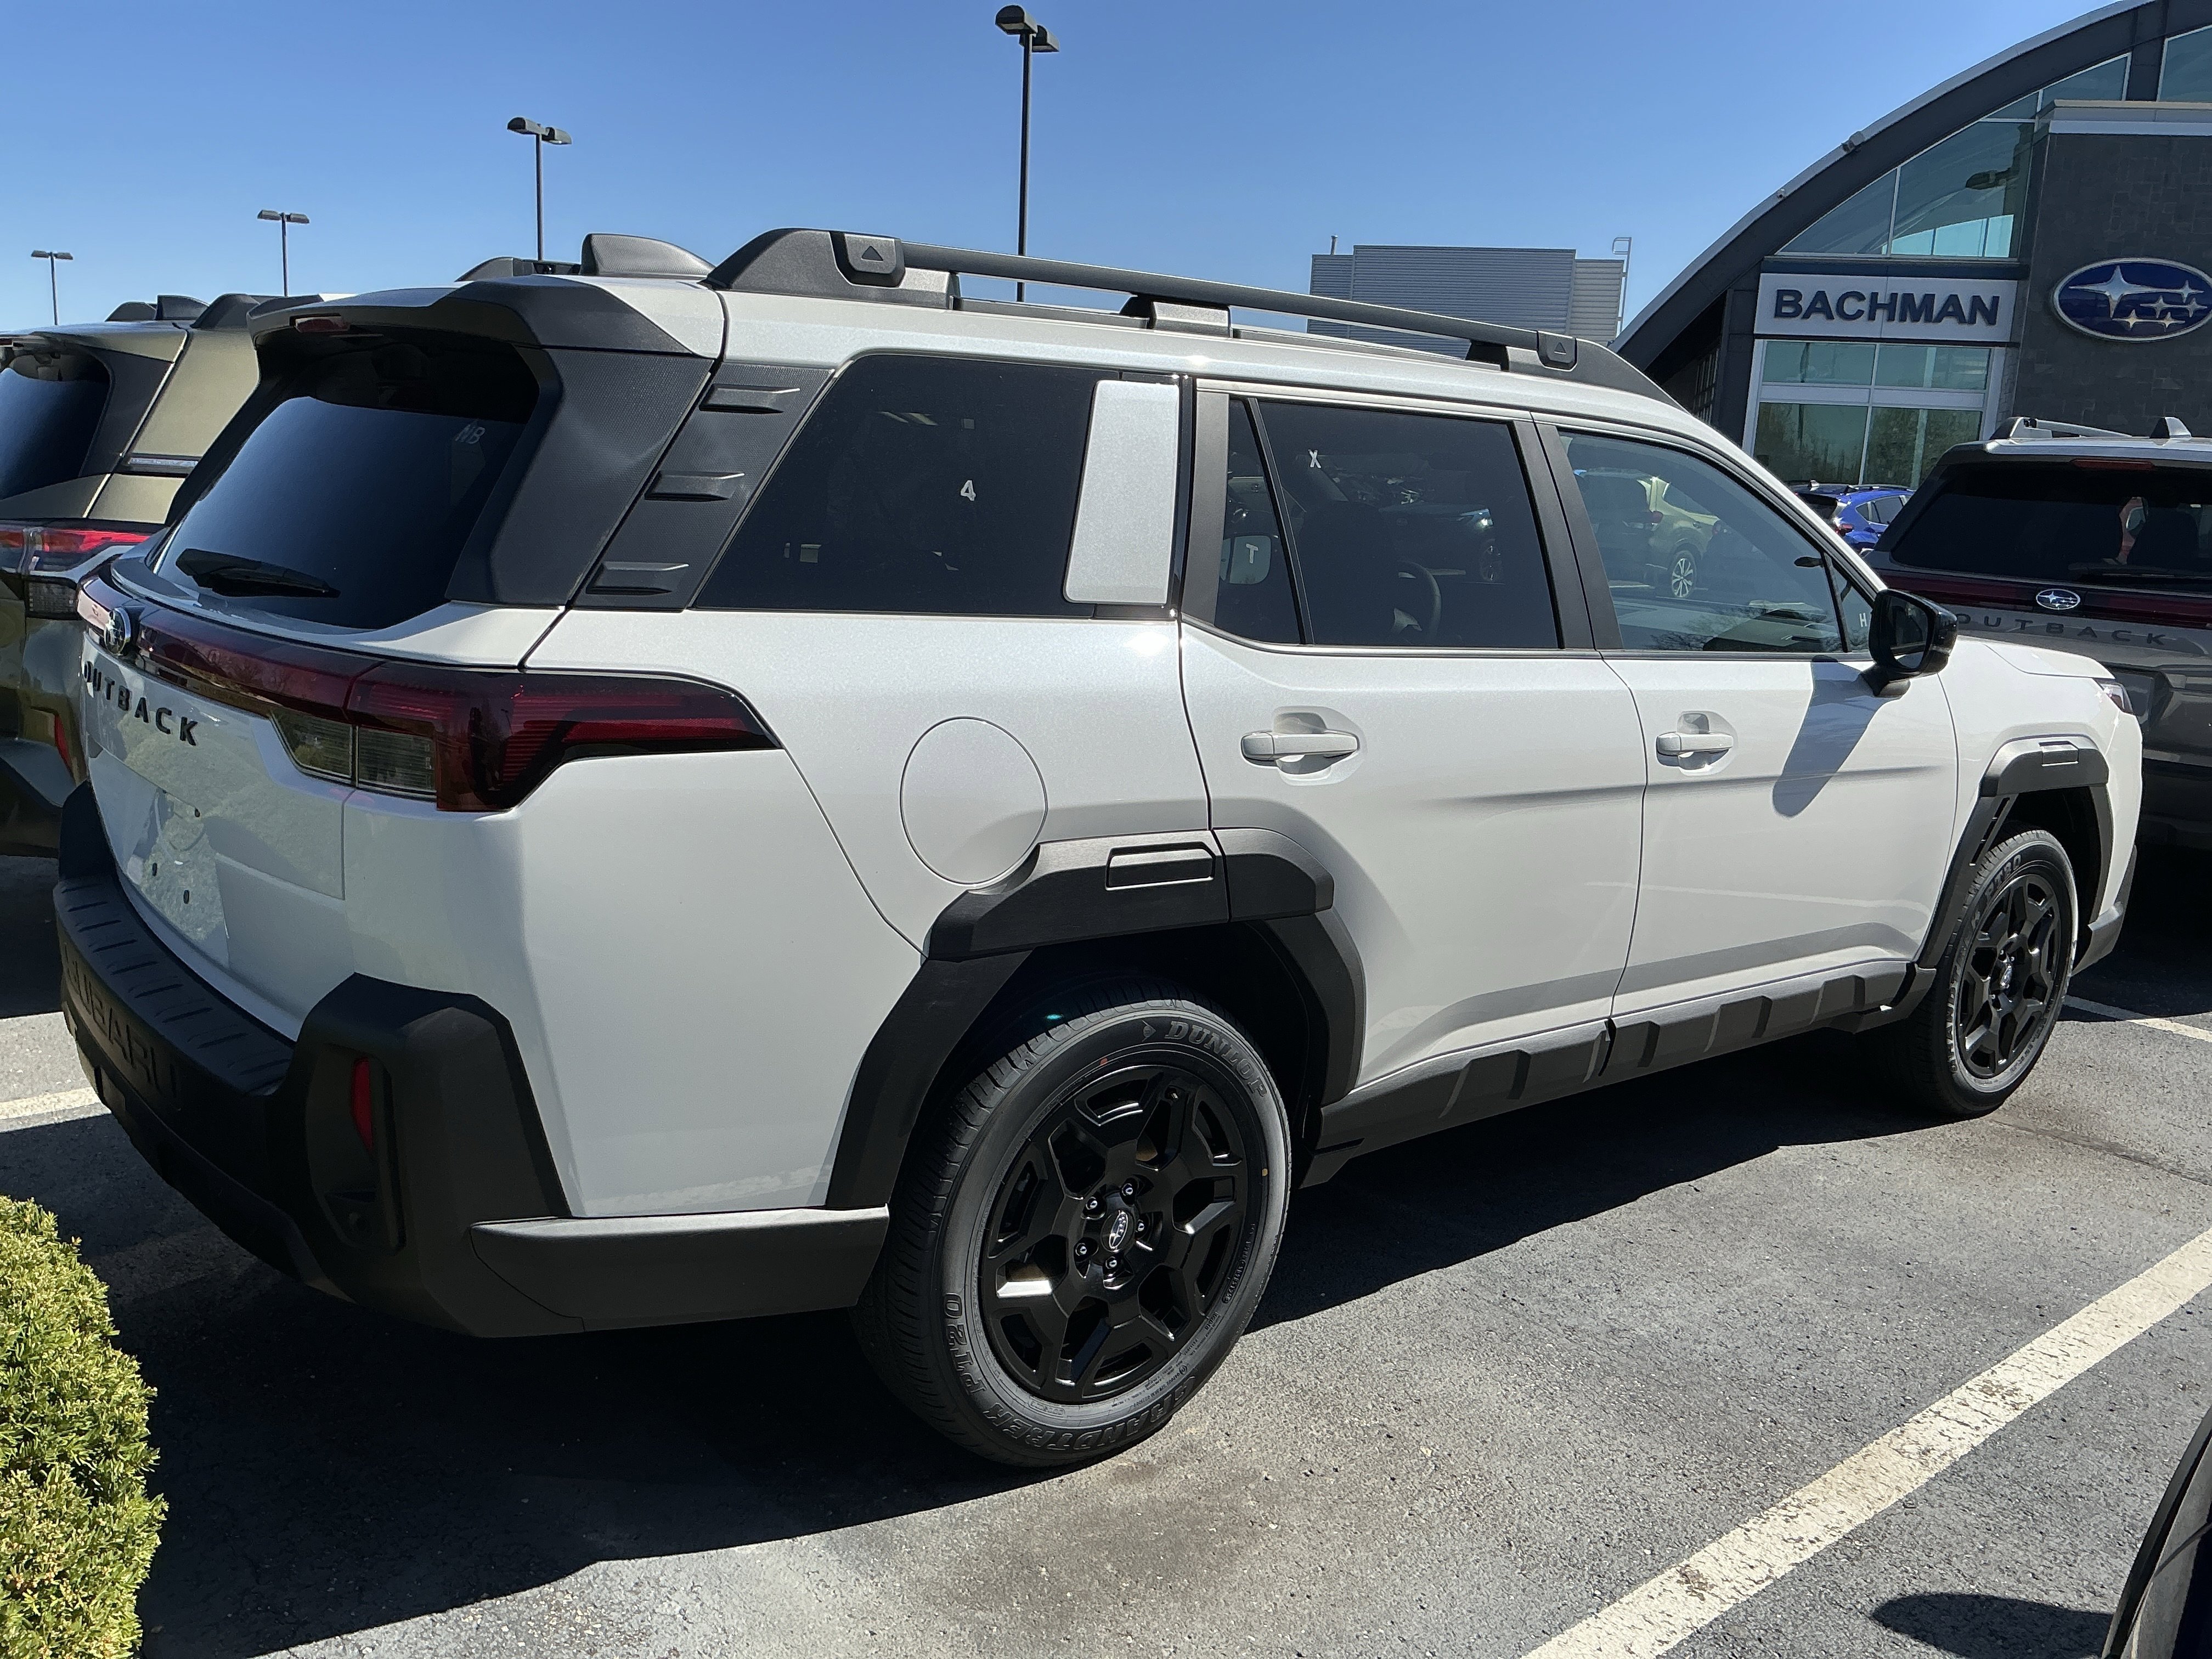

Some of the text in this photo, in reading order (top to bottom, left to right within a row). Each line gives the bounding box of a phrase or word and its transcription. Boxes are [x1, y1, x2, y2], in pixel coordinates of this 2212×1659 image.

[1774, 289, 2000, 325] BACHMAN
[1308, 449, 1322, 468] X
[960, 479, 977, 501] 4
[1246, 543, 1259, 564] T
[1859, 612, 1867, 628] H
[1956, 613, 2166, 645] OUTBACK
[82, 661, 198, 746] OUTBACK
[1164, 1021, 1268, 1097] DUNLOP
[943, 1293, 988, 1396] PT20
[982, 1375, 1196, 1451] GRANDTREK
